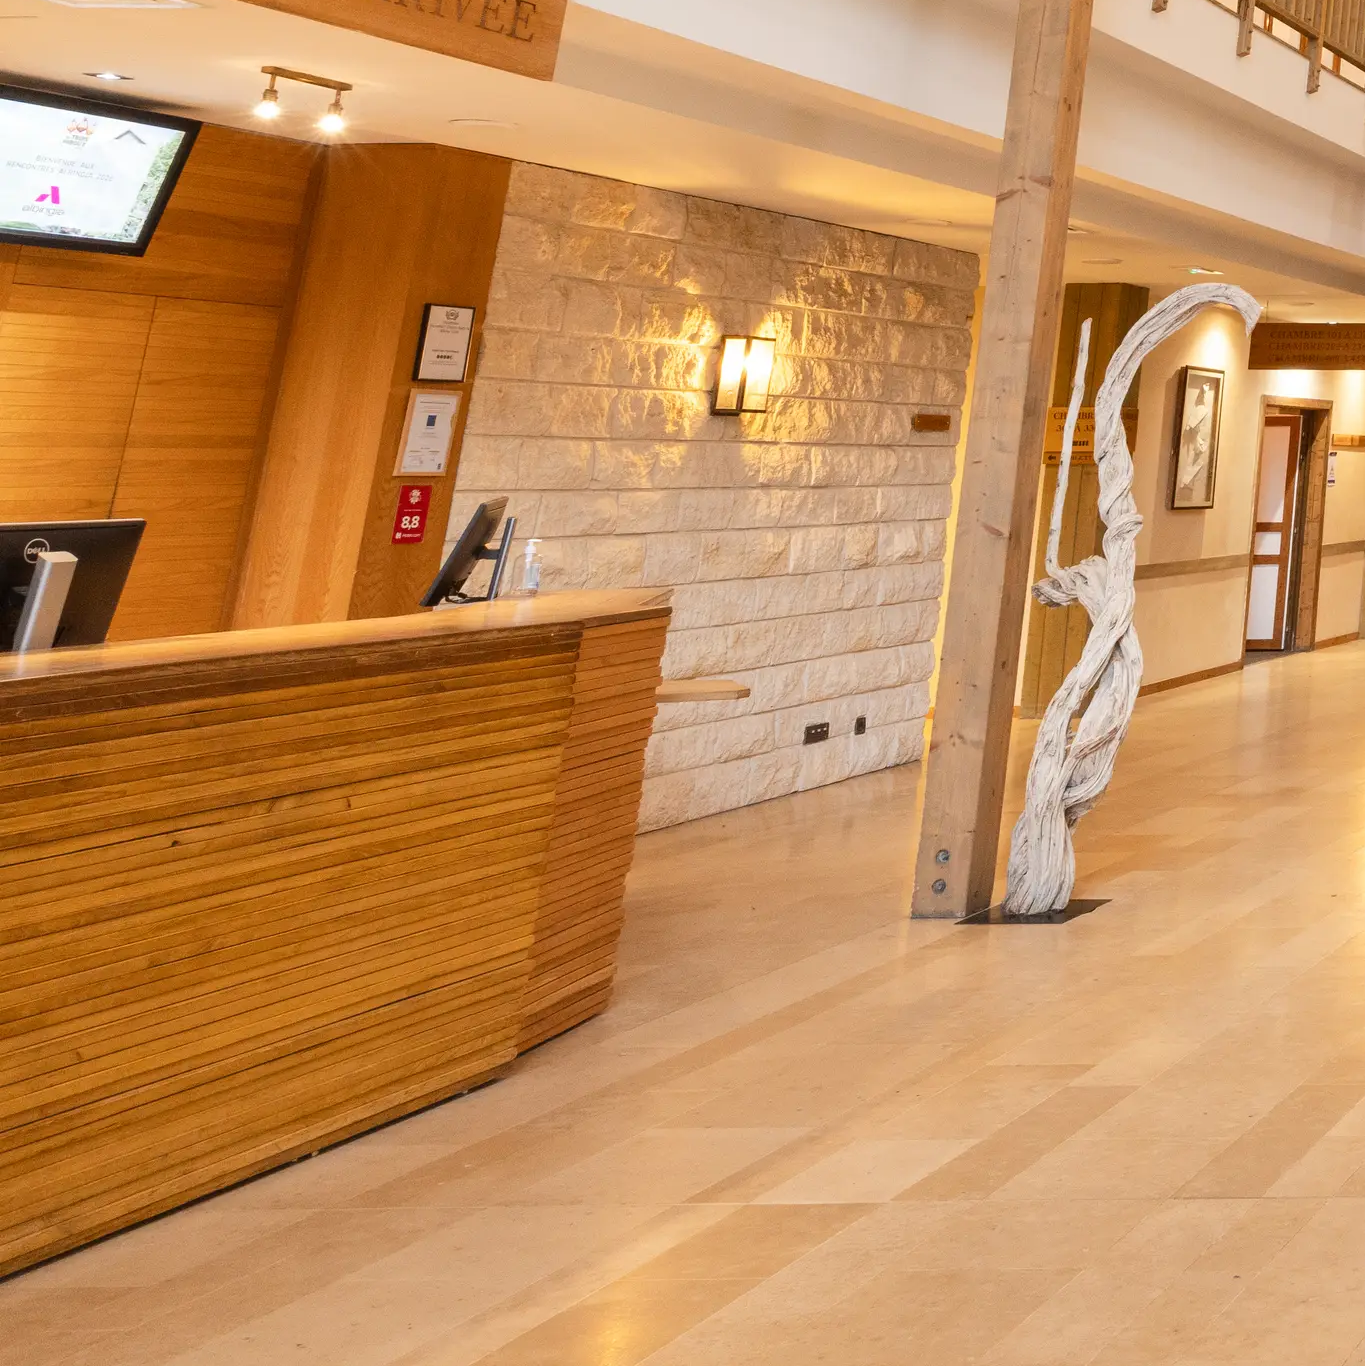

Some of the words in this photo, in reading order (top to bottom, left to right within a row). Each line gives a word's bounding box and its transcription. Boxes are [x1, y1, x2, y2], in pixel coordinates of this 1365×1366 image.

[6, 160, 55, 173] RENCONTRES
[1269, 330, 1325, 339] CHAMBRE
[400, 515, 421, 530] 8,8
